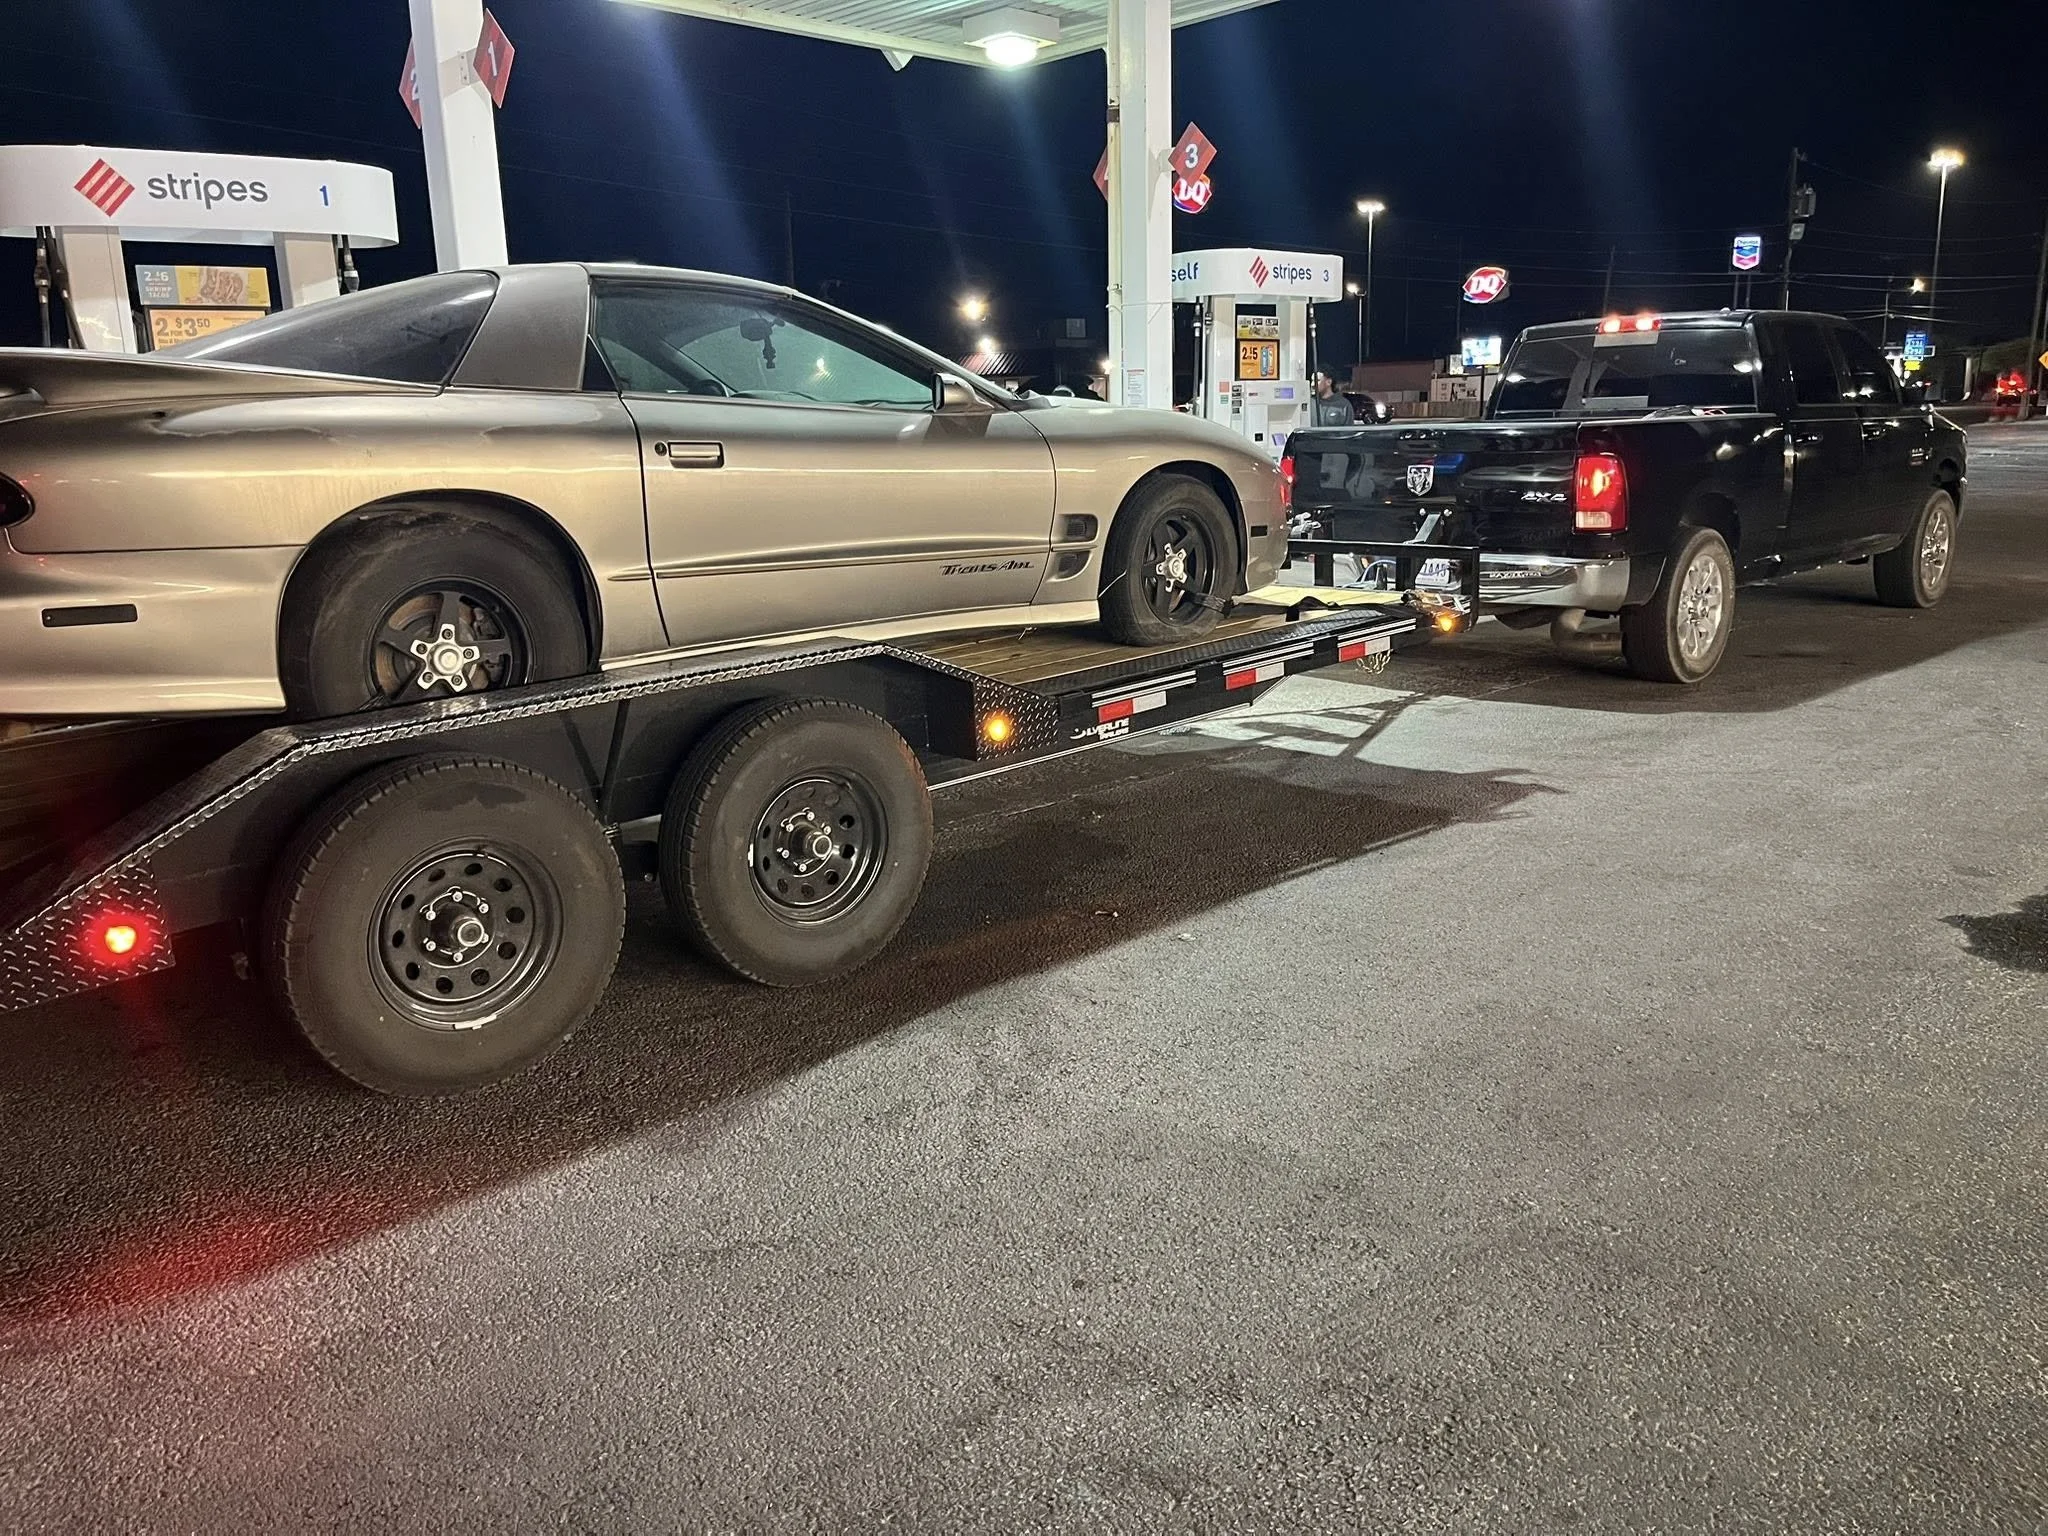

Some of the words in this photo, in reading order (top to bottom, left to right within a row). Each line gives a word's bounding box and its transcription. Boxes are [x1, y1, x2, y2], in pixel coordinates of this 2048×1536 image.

[487, 41, 498, 77] 1
[1185, 143, 1199, 169] 3
[148, 172, 269, 210] stripes
[319, 184, 330, 207] 1
[1179, 178, 1208, 206] DQ
[1273, 263, 1312, 285] stripes
[1323, 270, 1330, 282] 3
[1469, 273, 1501, 296] DQ
[155, 317, 169, 337] 2
